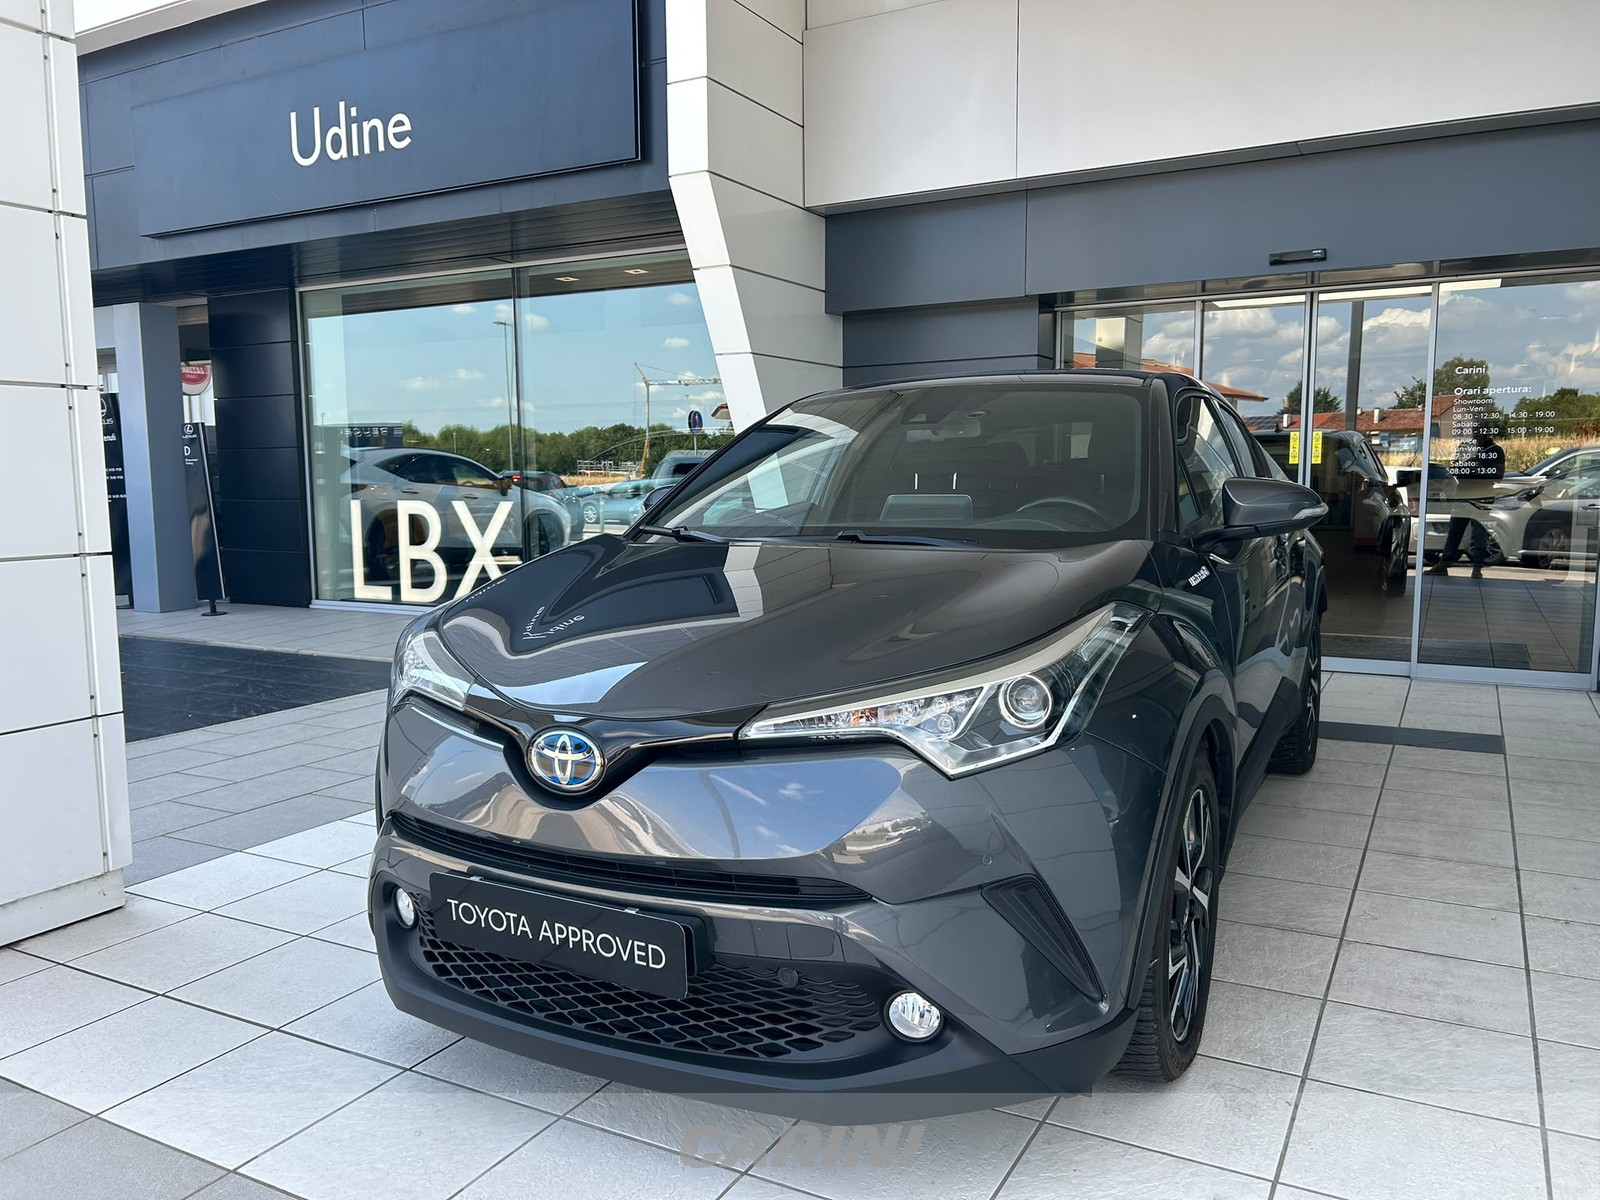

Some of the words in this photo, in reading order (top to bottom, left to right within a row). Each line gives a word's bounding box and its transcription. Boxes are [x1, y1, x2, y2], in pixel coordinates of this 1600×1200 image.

[289, 100, 413, 167] Udine
[1455, 365, 1486, 375] Carini
[1454, 387, 1481, 396] Orari
[1483, 386, 1532, 396] apertura:
[1452, 405, 1486, 413] Lun-Ven:
[1480, 412, 1500, 420] 12:30
[1508, 411, 1528, 419] 14:30
[1535, 410, 1556, 418] 19:00
[1452, 420, 1480, 428] Sabato:
[1479, 427, 1499, 435] 12:30
[1449, 460, 1478, 468] Sabato:
[1477, 467, 1497, 475] 13:00
[350, 500, 515, 603] LBX
[447, 899, 533, 939] TOYOTA
[539, 920, 667, 970] APPROVED
